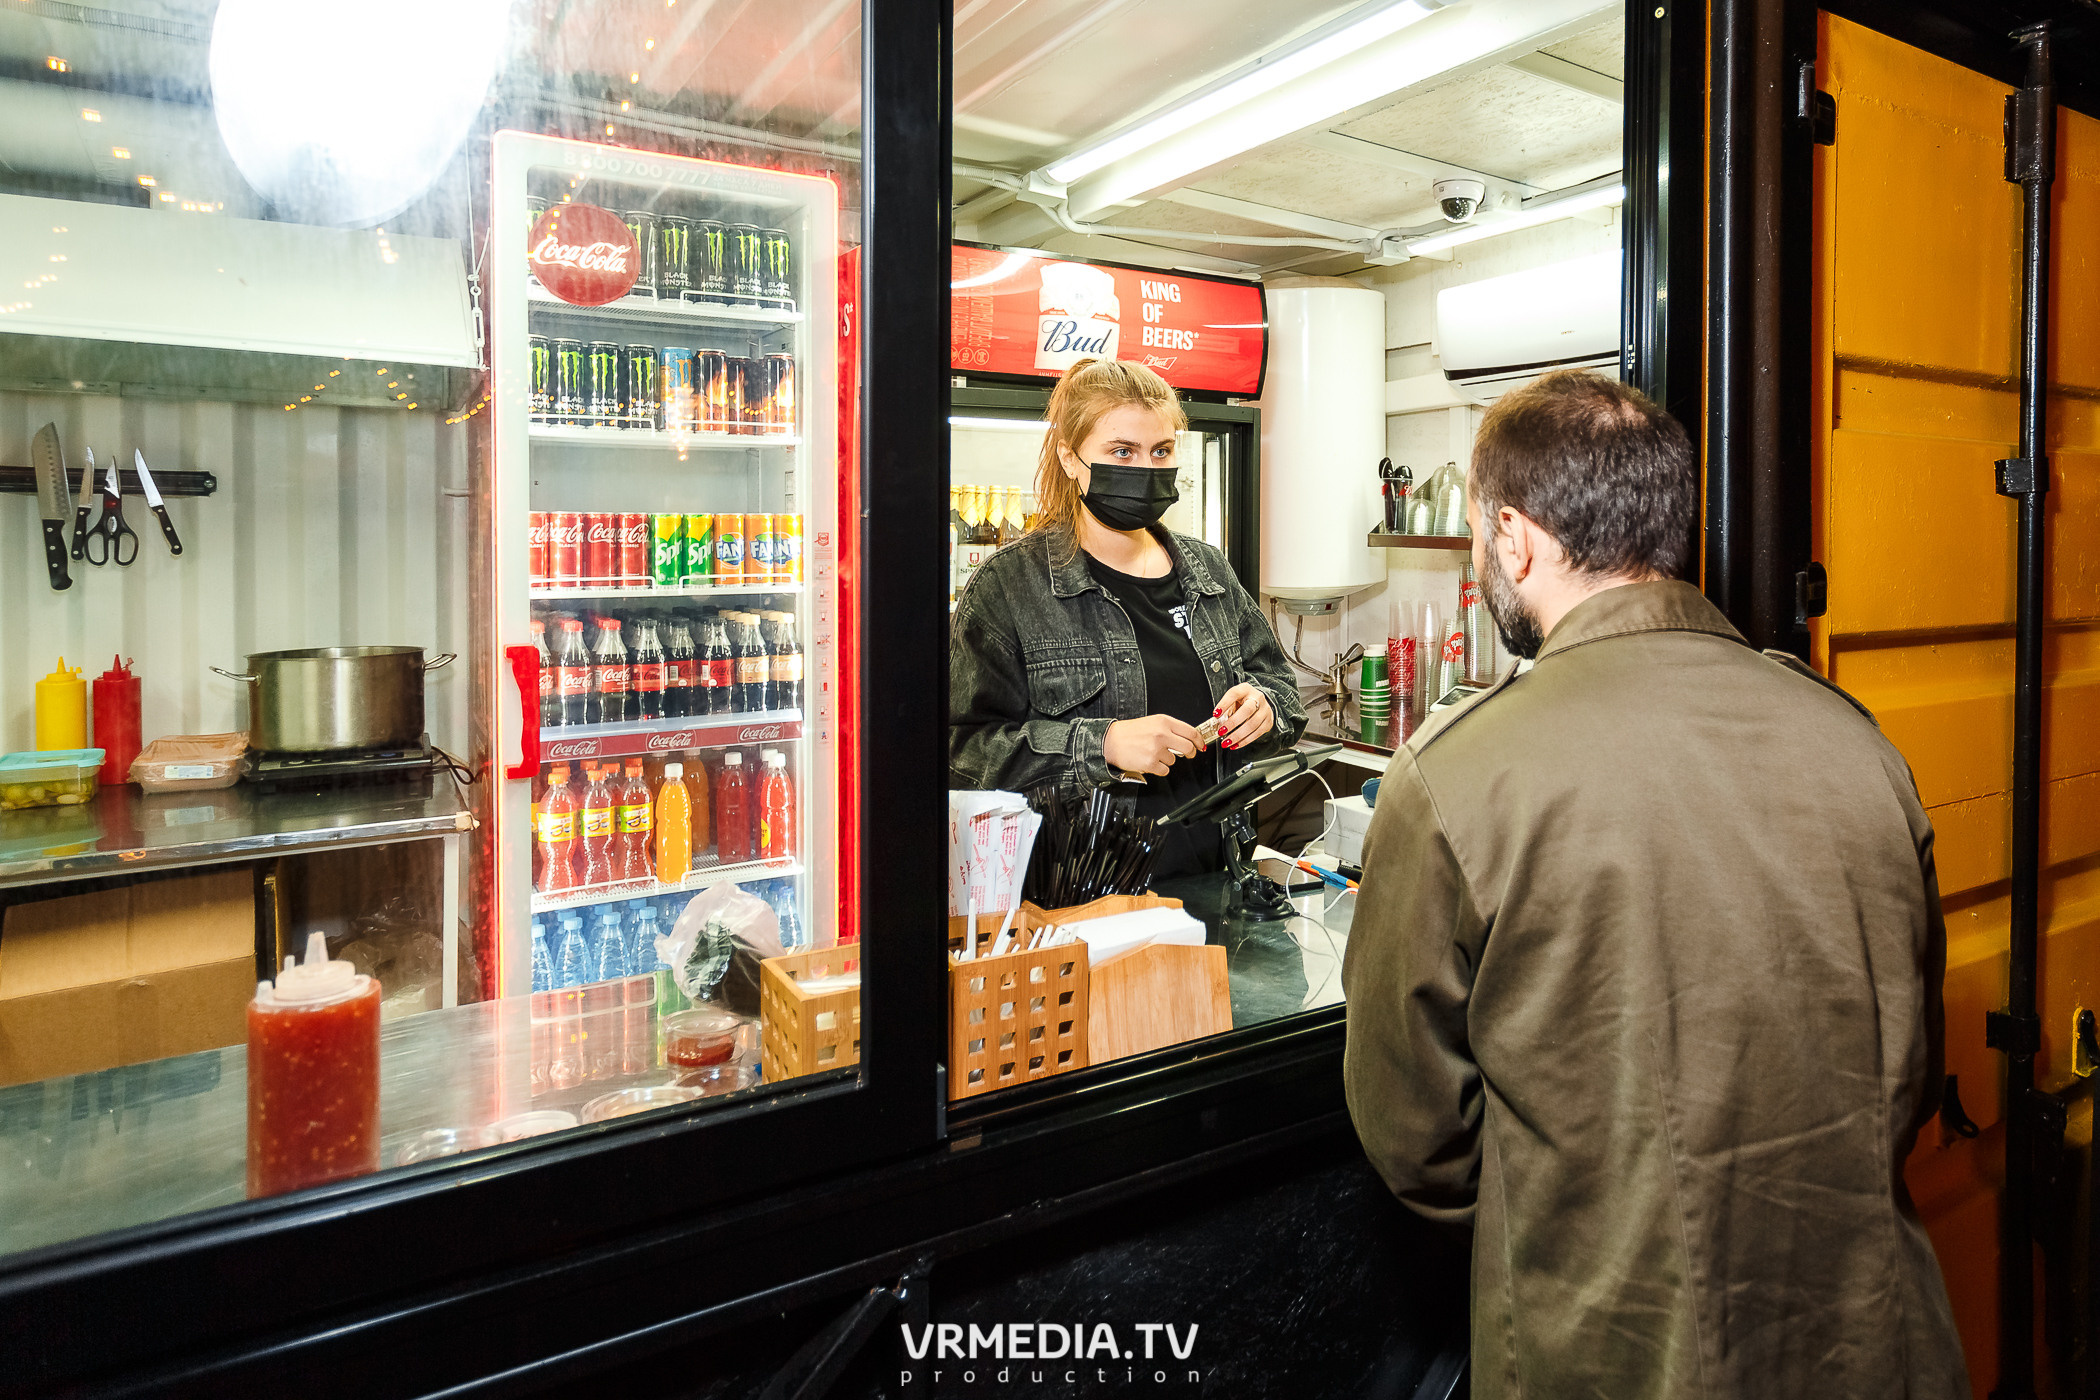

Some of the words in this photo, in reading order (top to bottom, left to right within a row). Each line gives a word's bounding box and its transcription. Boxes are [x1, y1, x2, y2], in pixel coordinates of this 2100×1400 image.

[533, 233, 632, 274] Coca-Cola
[1140, 280, 1181, 303] KING
[1142, 302, 1163, 323] OF
[1041, 319, 1113, 355] Bud
[648, 732, 694, 749] Coca-Cola
[739, 725, 782, 741] Coca-Cola
[550, 740, 599, 758] Coca-Cola
